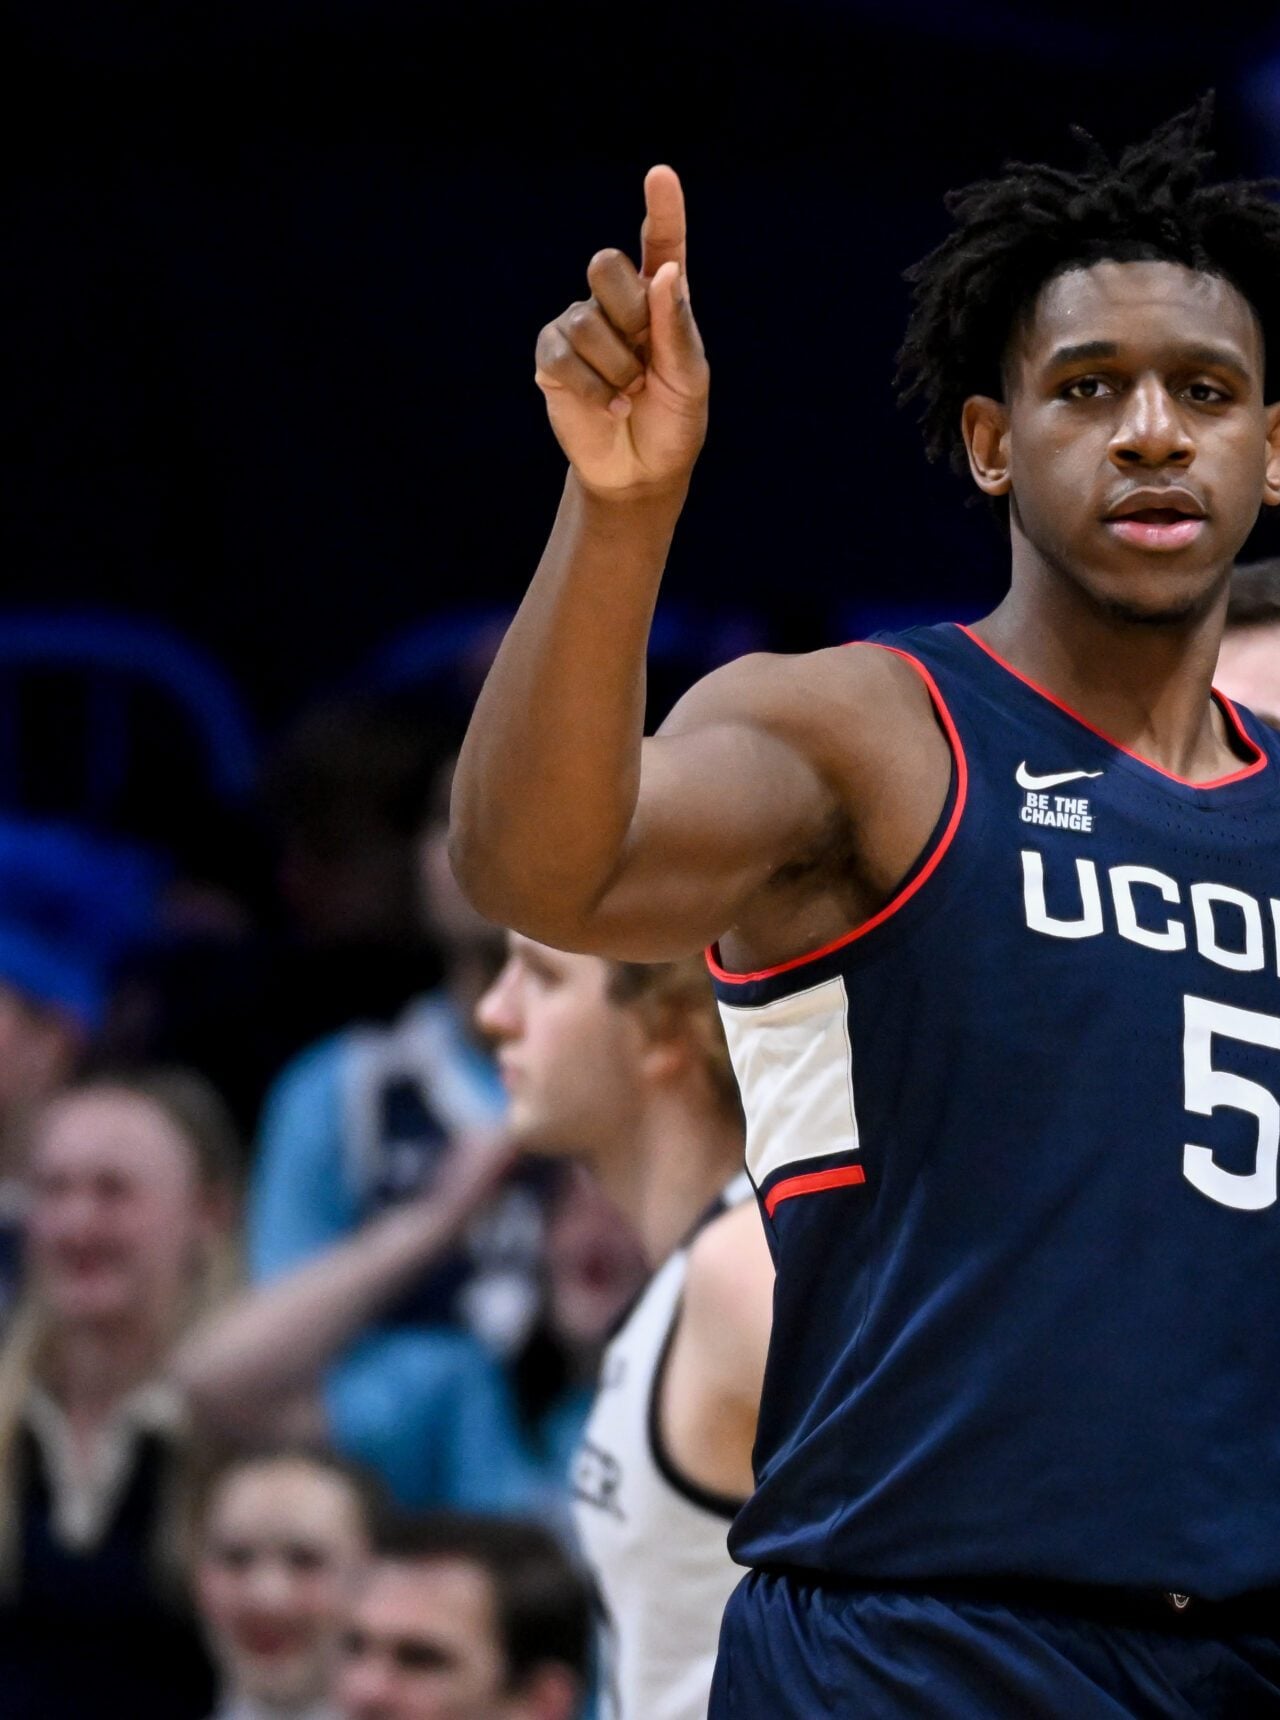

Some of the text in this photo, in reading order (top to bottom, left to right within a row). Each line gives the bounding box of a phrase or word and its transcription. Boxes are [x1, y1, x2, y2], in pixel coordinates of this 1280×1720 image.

[1026, 792, 1089, 815] BE THE
[1021, 806, 1093, 832] CHANGE
